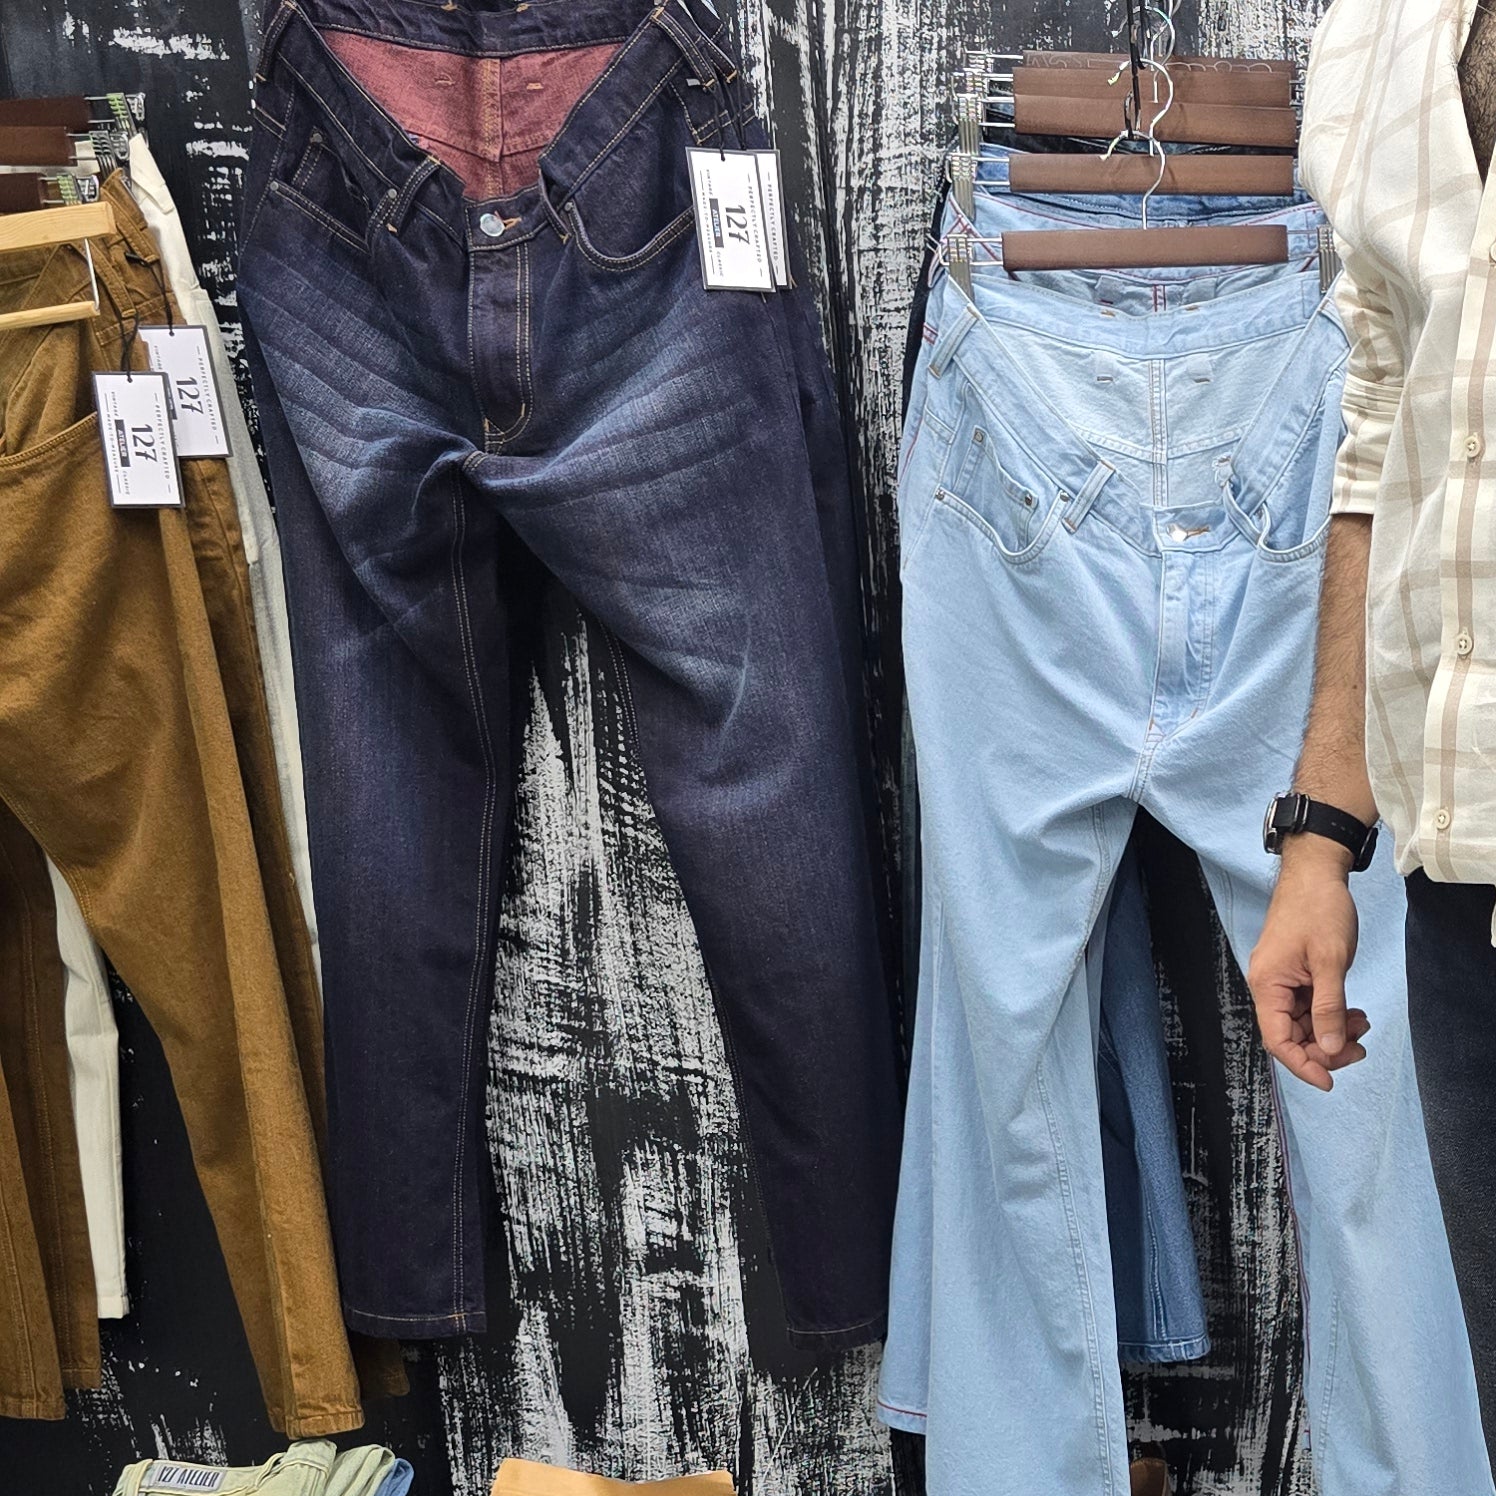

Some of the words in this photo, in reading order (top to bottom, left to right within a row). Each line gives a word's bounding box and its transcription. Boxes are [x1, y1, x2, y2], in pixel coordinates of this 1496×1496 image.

[725, 204, 750, 245] 127
[748, 186, 758, 228] PERFECTLY
[754, 230, 762, 263] CRAFTED
[768, 184, 776, 226] PERFECTLY
[176, 377, 204, 414] 127
[198, 358, 210, 397] PERFECTLY
[208, 398, 217, 431] CRAFTED
[118, 429, 128, 458] ATELIER
[131, 424, 158, 463] 127
[155, 404, 164, 446] PERFECTLY
[161, 446, 170, 480] CRAFTED
[177, 1469, 220, 1487] ATELIER
